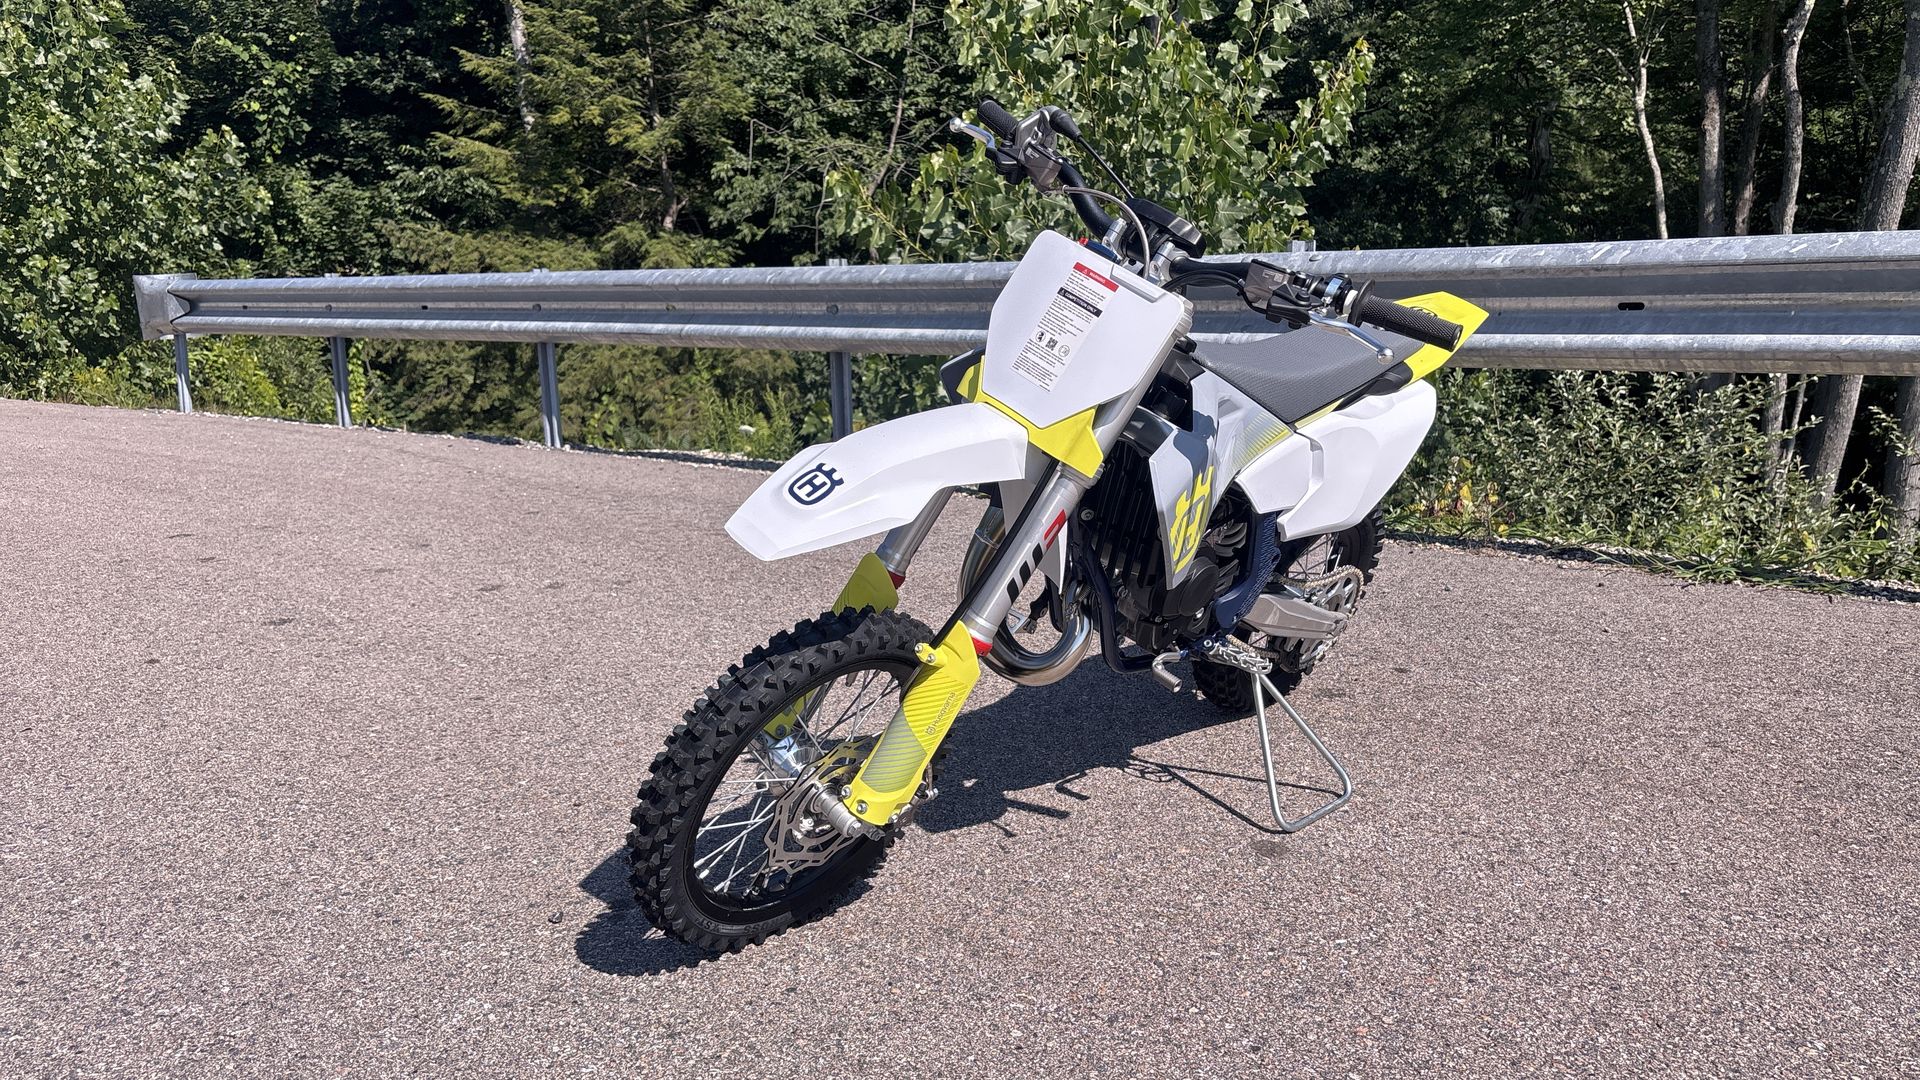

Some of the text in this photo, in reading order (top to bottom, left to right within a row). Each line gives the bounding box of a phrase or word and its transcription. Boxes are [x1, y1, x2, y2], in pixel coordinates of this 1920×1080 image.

[1064, 292, 1097, 313] COMPETITION ONLY
[932, 691, 955, 727] Husqvarna
